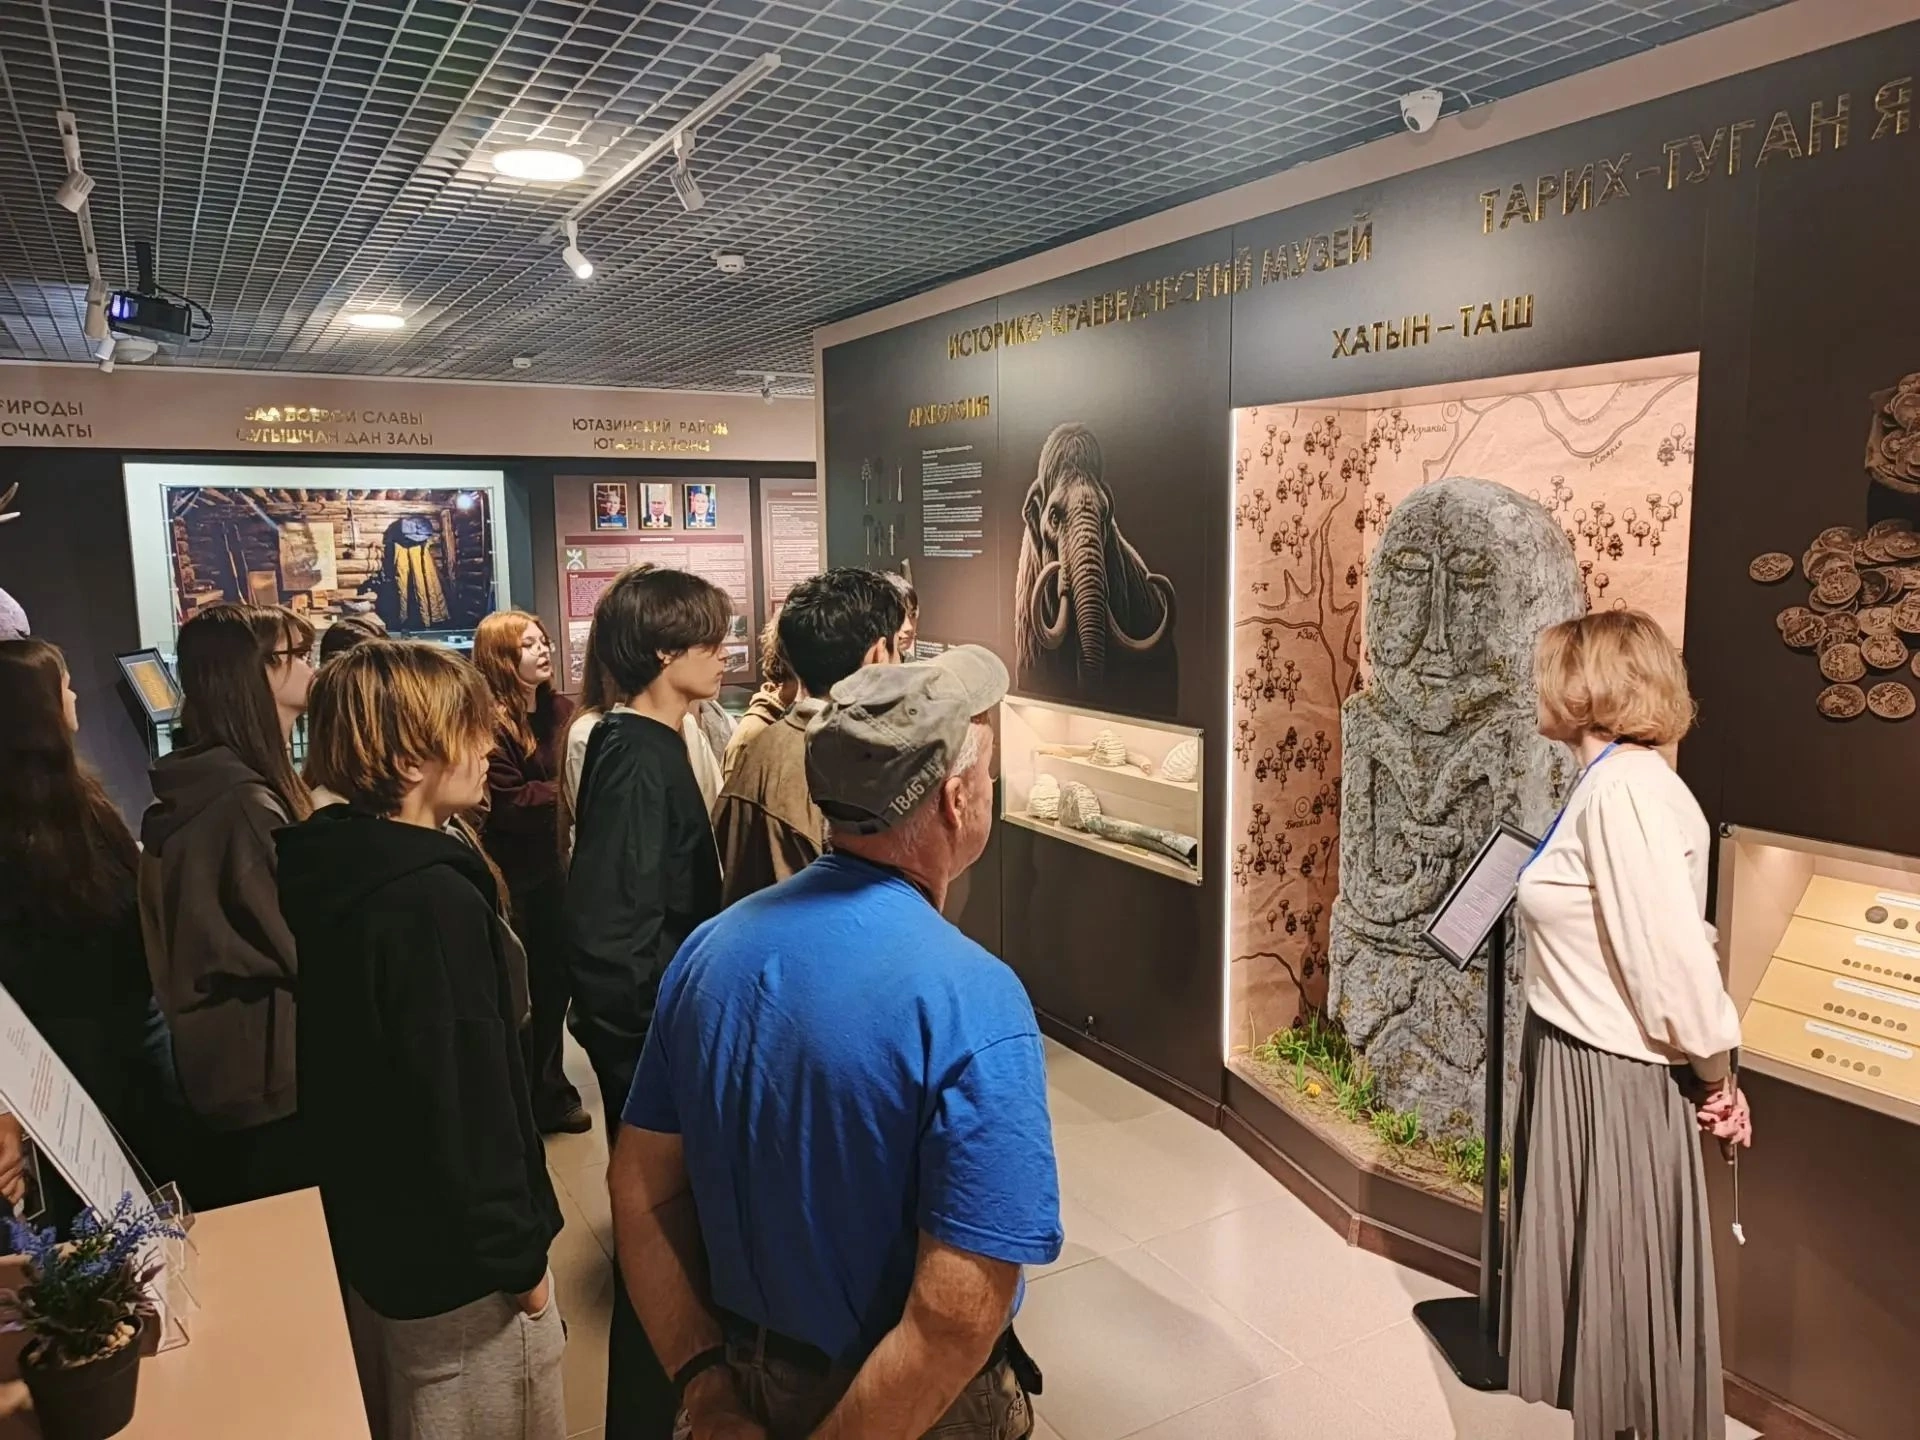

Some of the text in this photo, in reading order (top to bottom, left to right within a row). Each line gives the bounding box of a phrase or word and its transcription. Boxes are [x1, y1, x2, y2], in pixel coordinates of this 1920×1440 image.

[1870, 76, 1920, 141] Я
[1260, 211, 1374, 288] МУЗЕЙ
[0, 399, 84, 416] ИРОДЫ
[362, 410, 424, 426] СЛАВЫ
[572, 418, 672, 433] ЮТАЗИНСКИЙ
[344, 431, 382, 445] ДАН
[386, 431, 434, 446] ЗАЛЫ
